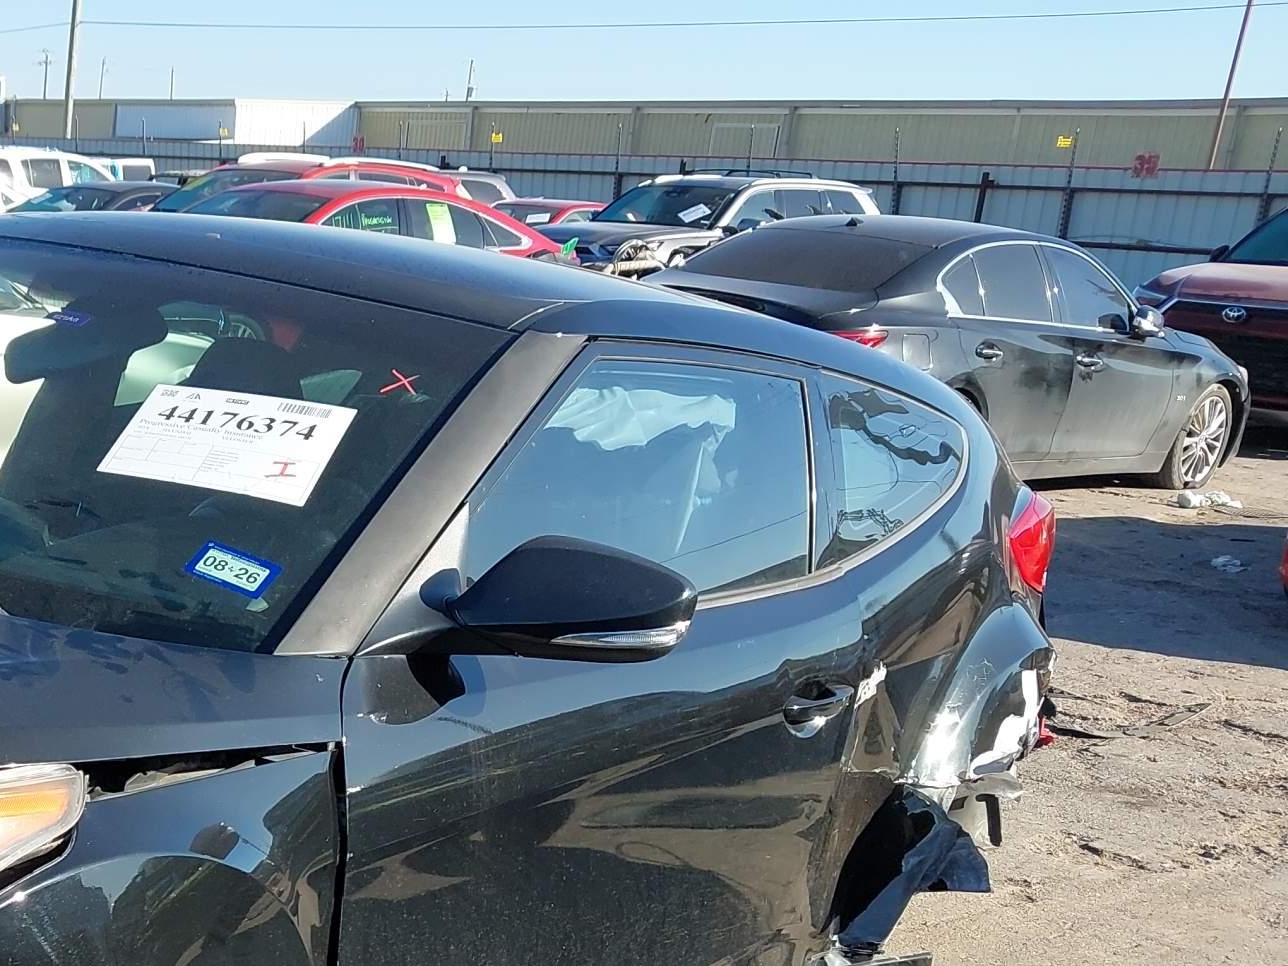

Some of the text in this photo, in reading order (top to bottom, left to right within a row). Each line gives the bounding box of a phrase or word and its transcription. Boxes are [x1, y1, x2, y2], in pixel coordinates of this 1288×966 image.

[157, 405, 318, 442] 44176374
[202, 555, 229, 572] 08
[233, 567, 261, 584] 26
